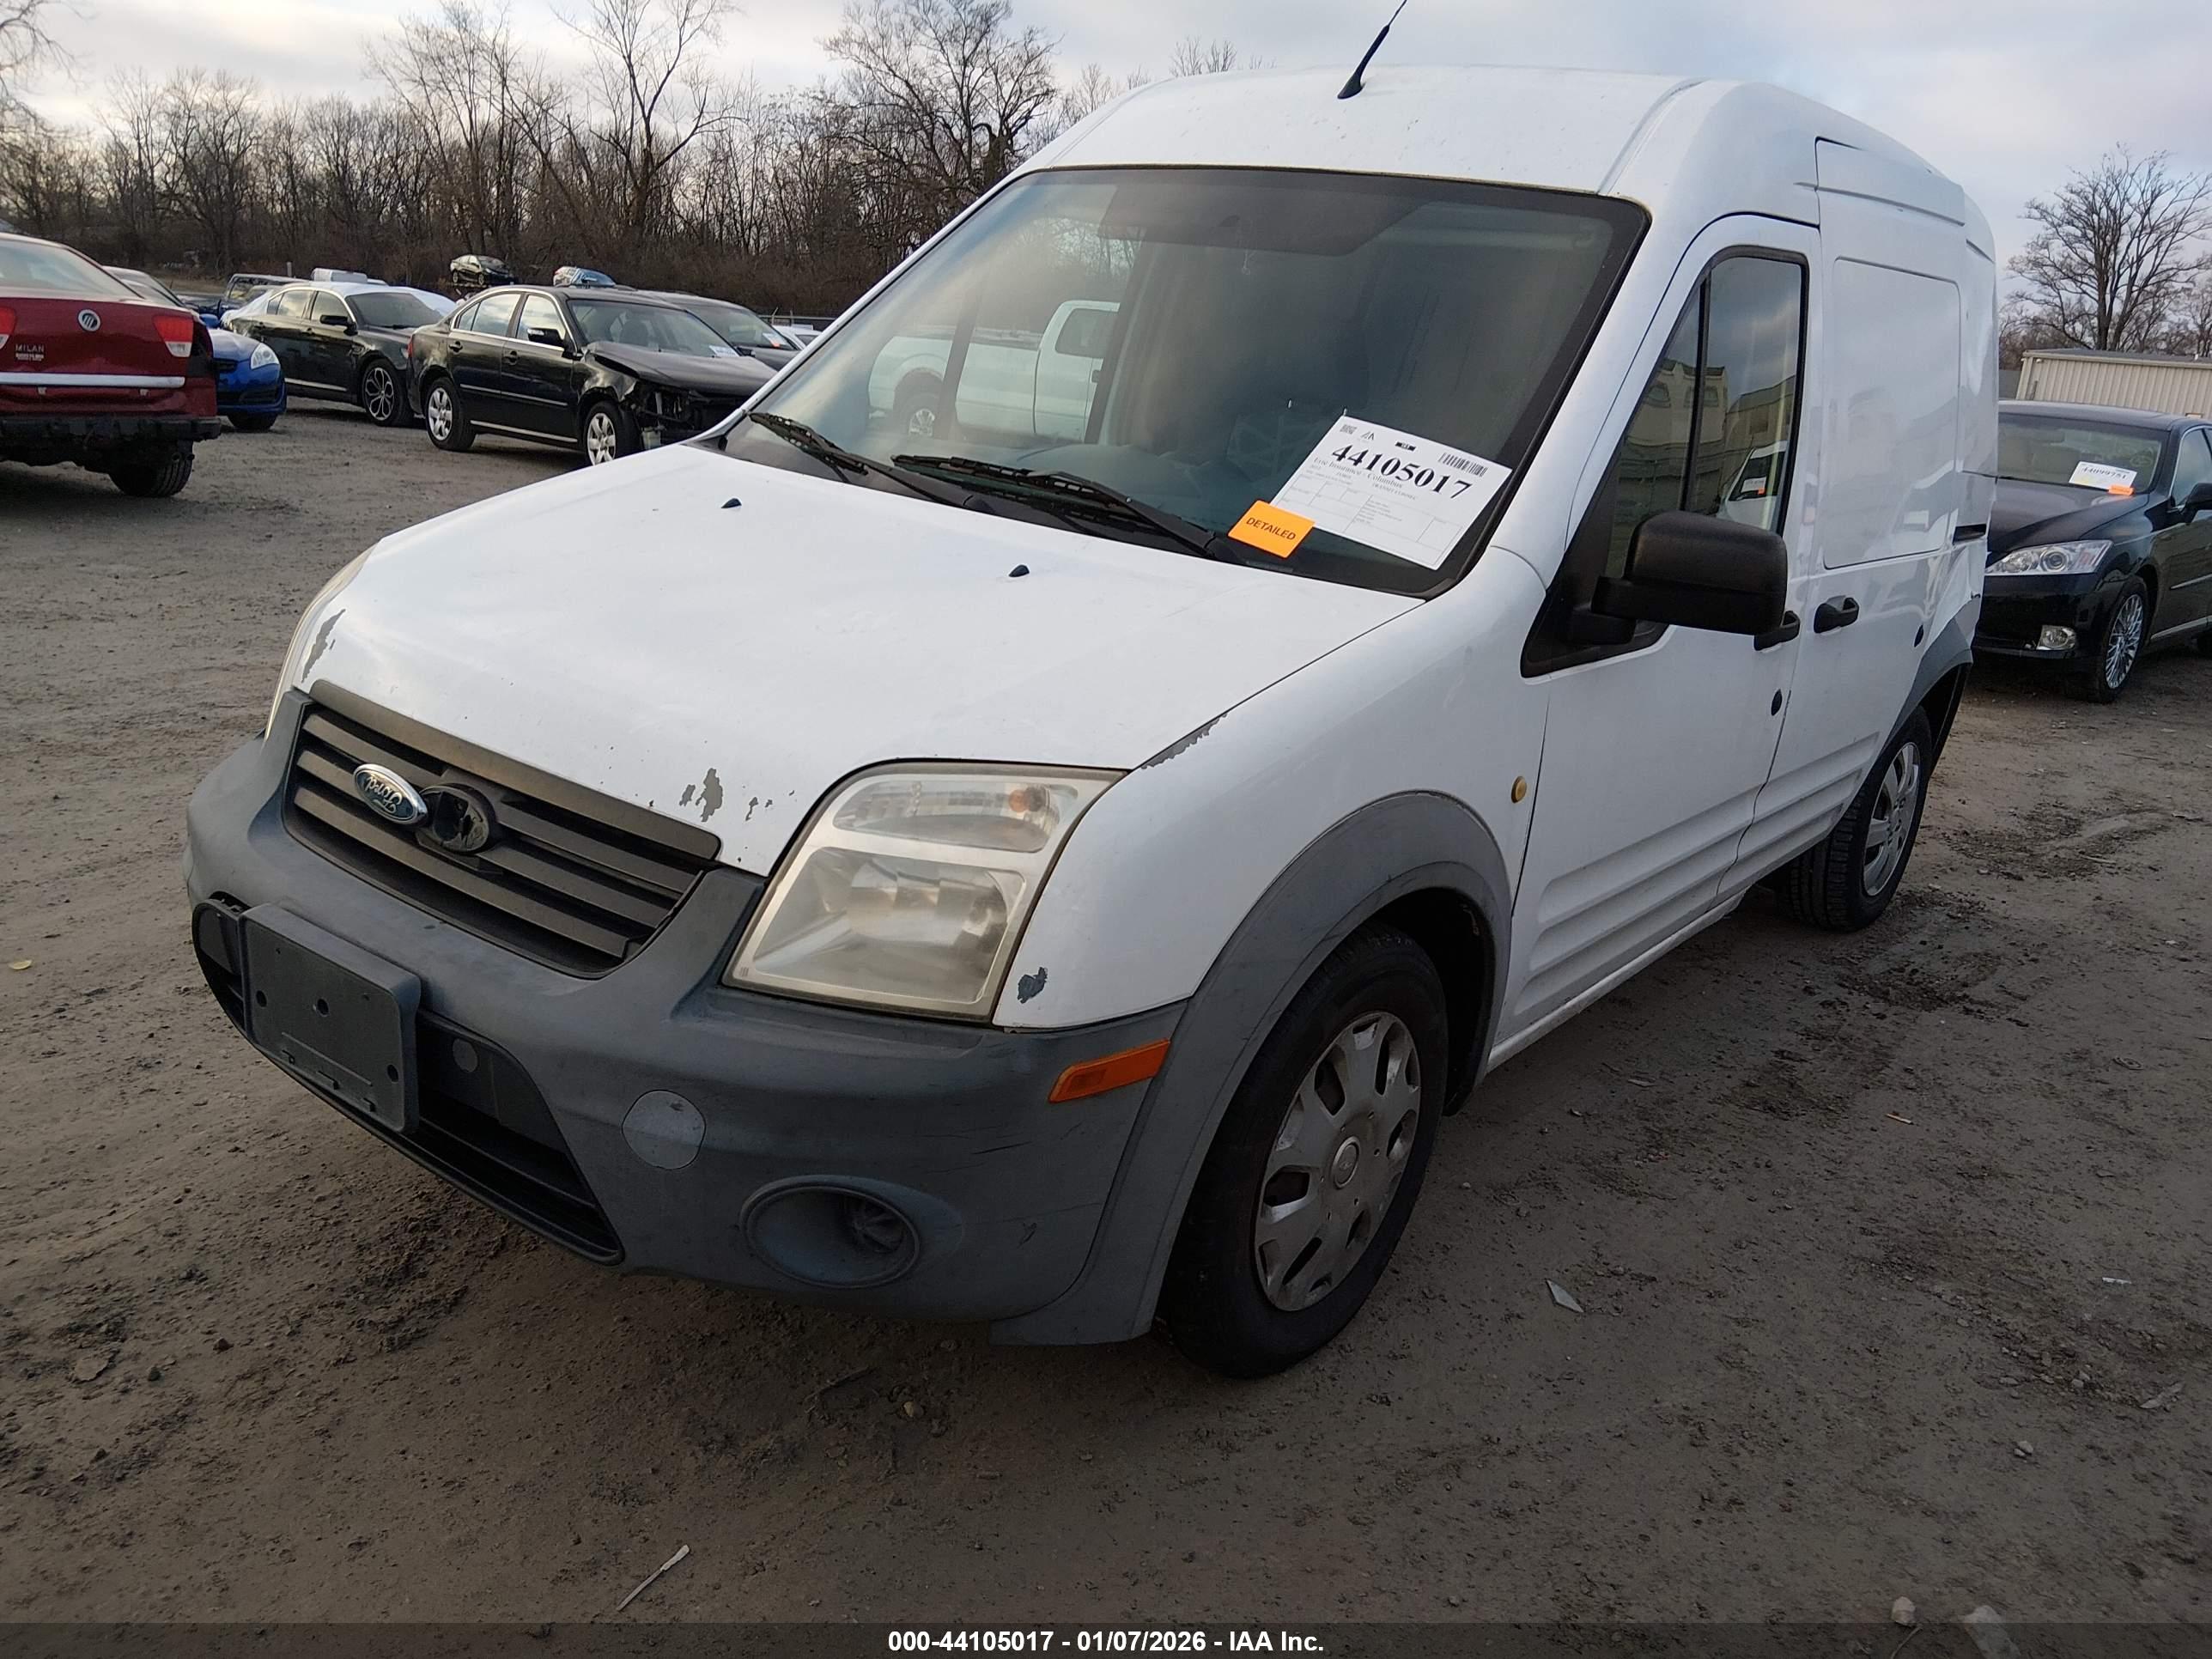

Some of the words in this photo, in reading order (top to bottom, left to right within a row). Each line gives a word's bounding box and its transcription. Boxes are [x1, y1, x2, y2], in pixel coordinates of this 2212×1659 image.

[15, 343, 44, 352] MILAN
[1331, 444, 1473, 499] 44105017
[1246, 517, 1297, 540] DETAILED
[365, 775, 403, 813] Ford
